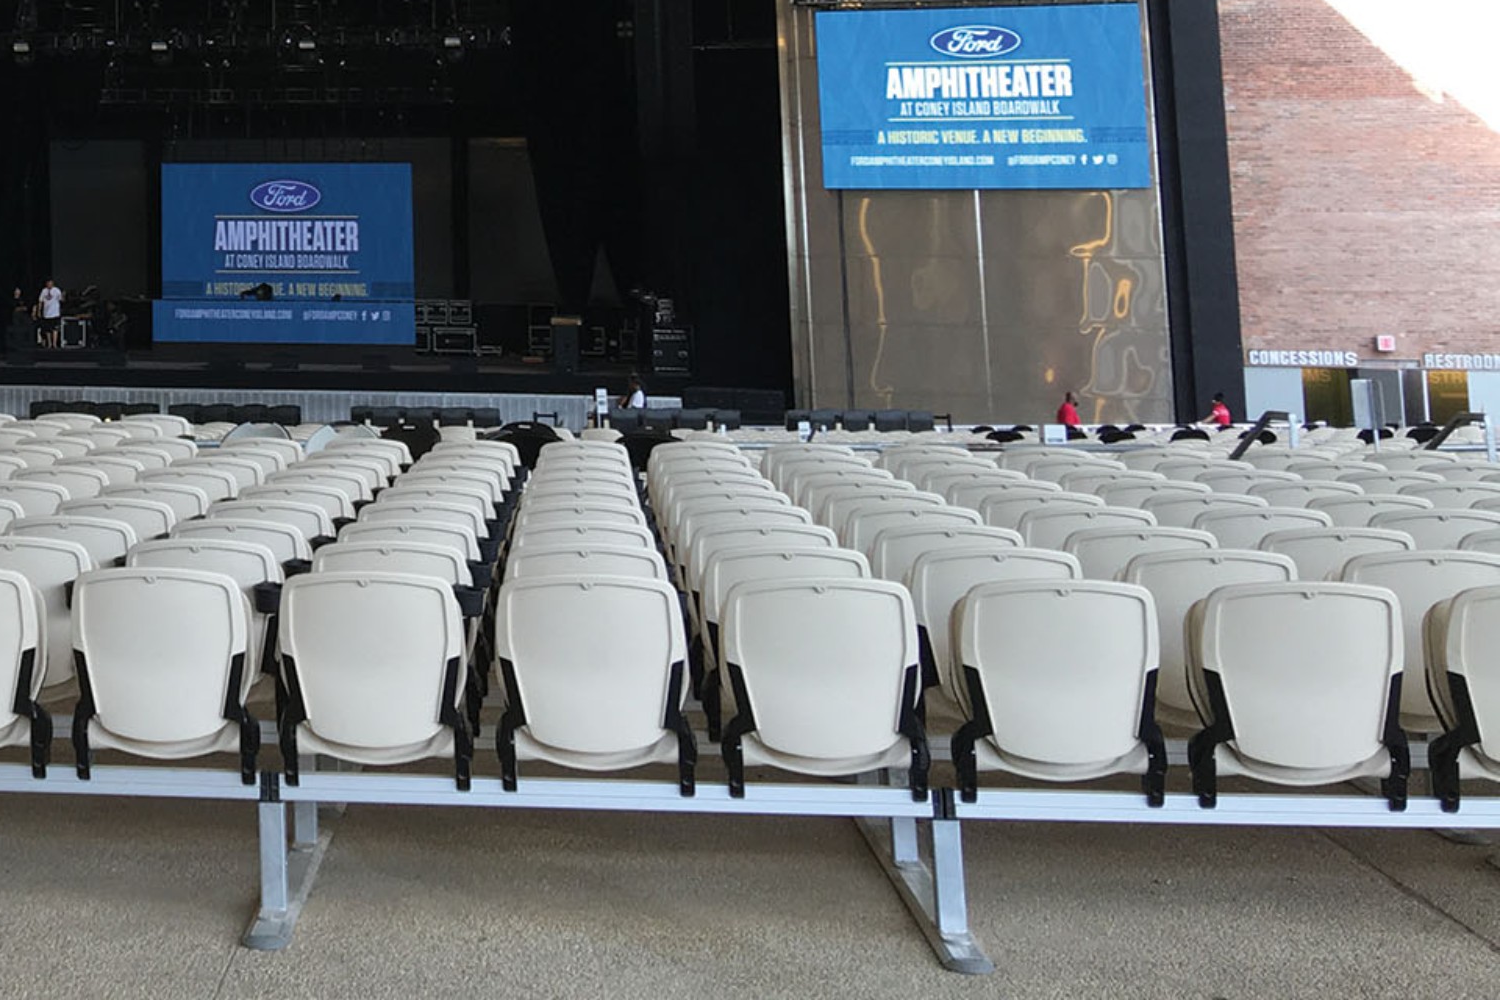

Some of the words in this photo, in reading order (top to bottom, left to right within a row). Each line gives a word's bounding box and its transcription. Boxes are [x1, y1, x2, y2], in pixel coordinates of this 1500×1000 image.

[947, 29, 1004, 53] Ford
[886, 64, 1073, 100] AMPHITHEATER
[900, 102, 912, 117] AT
[915, 102, 950, 116] CONEY
[952, 101, 990, 116] ISLAND
[994, 100, 1060, 115] BOARDWALK
[877, 130, 886, 145] A
[888, 130, 939, 145] HISTORIC
[941, 129, 980, 145] VENUE.
[982, 129, 993, 144] A
[993, 129, 1020, 144] NEW
[1021, 127, 1088, 144] BEGINNING.
[263, 183, 307, 206] Ford
[214, 220, 360, 252] AMPHITHEATER
[224, 254, 235, 268] AT
[235, 254, 265, 268] CONEY
[265, 254, 295, 268] ISLAND
[297, 253, 349, 269] BOARDWALK
[205, 282, 213, 296] A
[288, 282, 295, 296] A
[296, 282, 317, 296] NEW
[1249, 350, 1358, 366] CONCESSIONS
